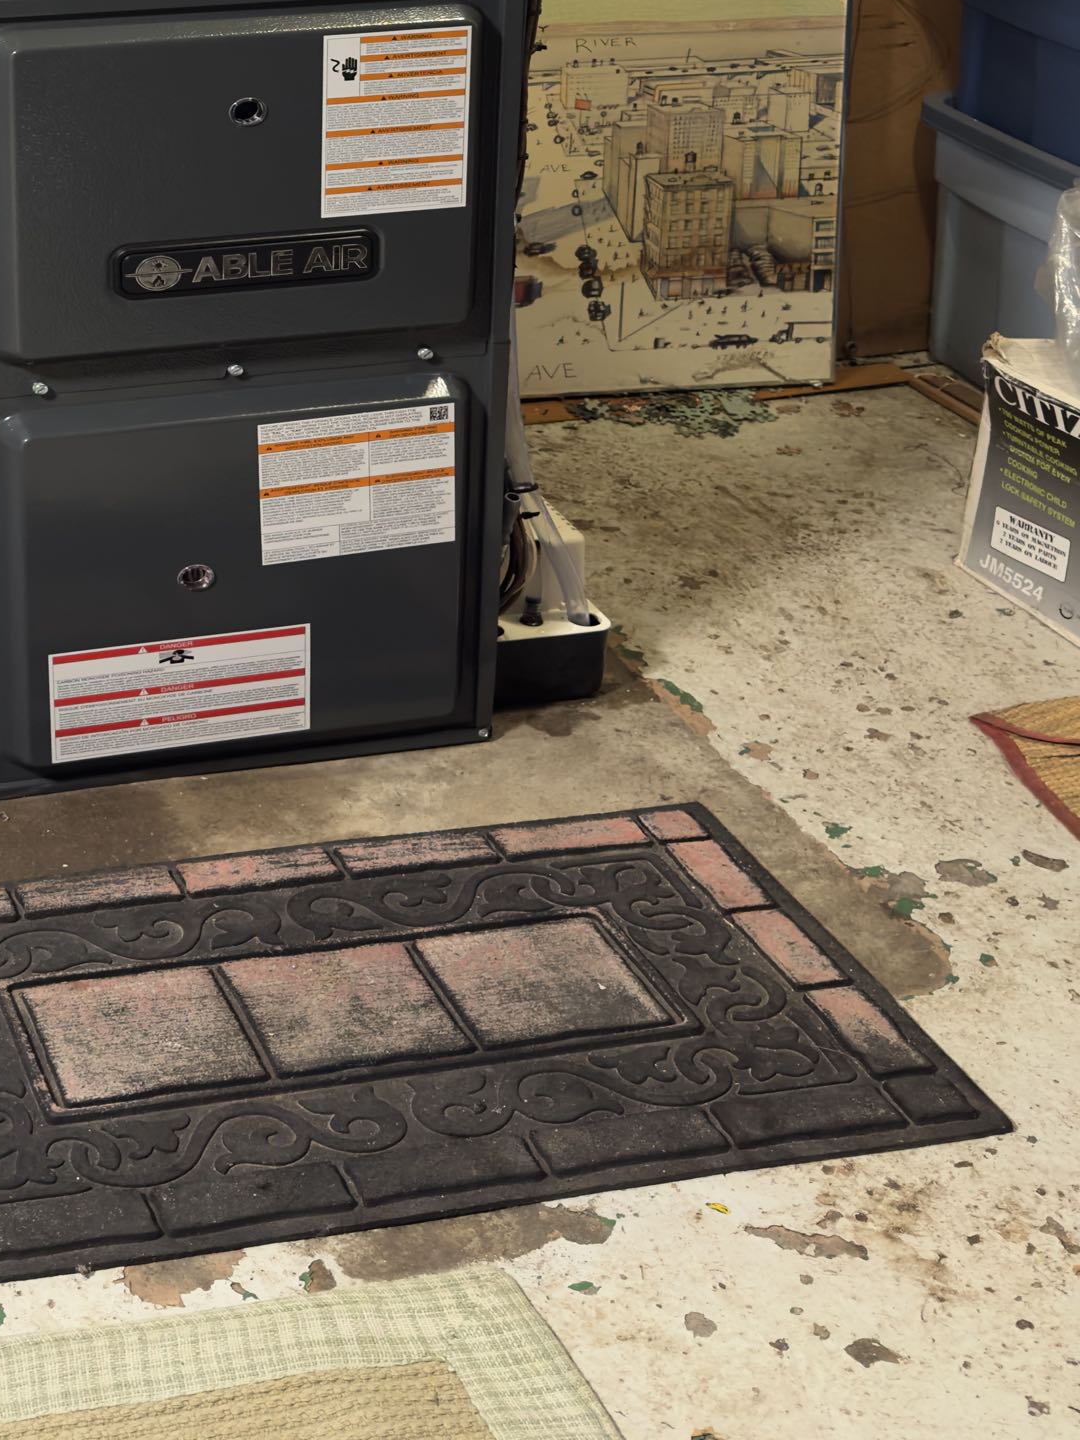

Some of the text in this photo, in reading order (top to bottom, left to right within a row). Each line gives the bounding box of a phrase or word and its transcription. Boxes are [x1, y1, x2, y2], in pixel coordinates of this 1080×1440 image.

[575, 36, 637, 54] RIVER
[191, 244, 368, 283] ABLE AIR
[526, 362, 578, 382] AVE
[1009, 516, 1055, 542] WARRANTY
[979, 554, 1044, 602] JM5524
[159, 640, 194, 650] DANGER
[160, 683, 195, 693] DANGER
[161, 712, 197, 723] PELIGRO
